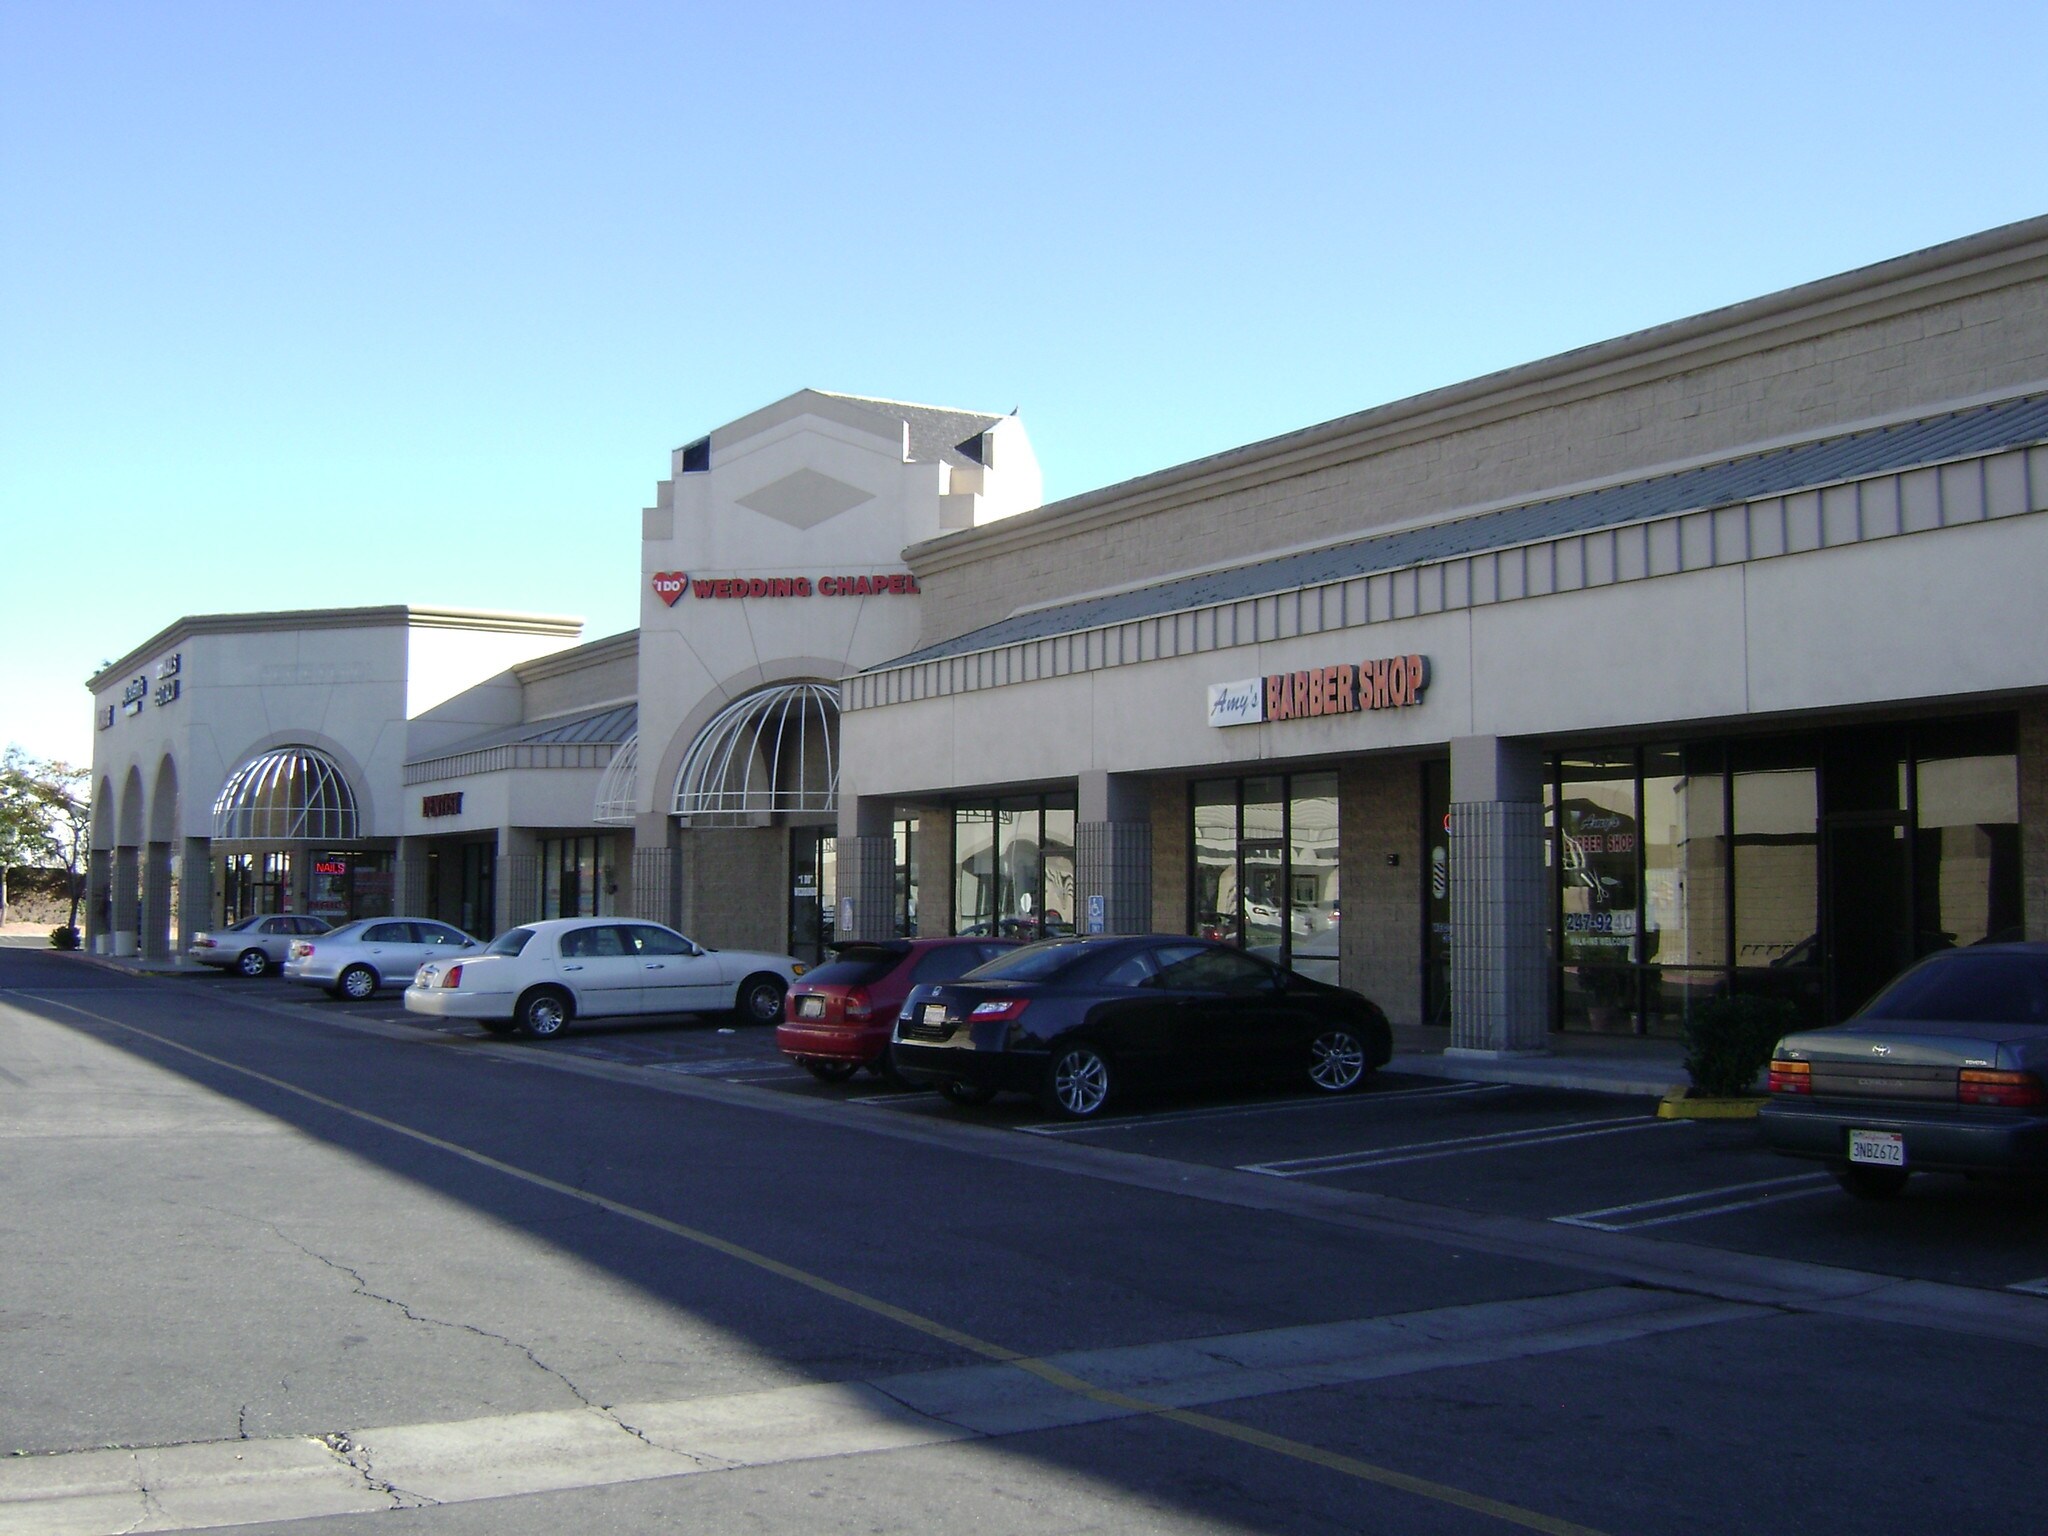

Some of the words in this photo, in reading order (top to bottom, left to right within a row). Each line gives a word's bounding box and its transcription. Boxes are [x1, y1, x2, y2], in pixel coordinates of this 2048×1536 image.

[691, 577, 812, 599] WEDDING
[818, 575, 921, 597] CHAPEL
[1267, 663, 1356, 721] BARBER
[1359, 653, 1427, 711] SHOP
[1211, 684, 1258, 717] Amy's
[1607, 833, 1634, 853] SHOP
[315, 862, 346, 875] NAILS
[1853, 1142, 1900, 1162] 3NBZ672
